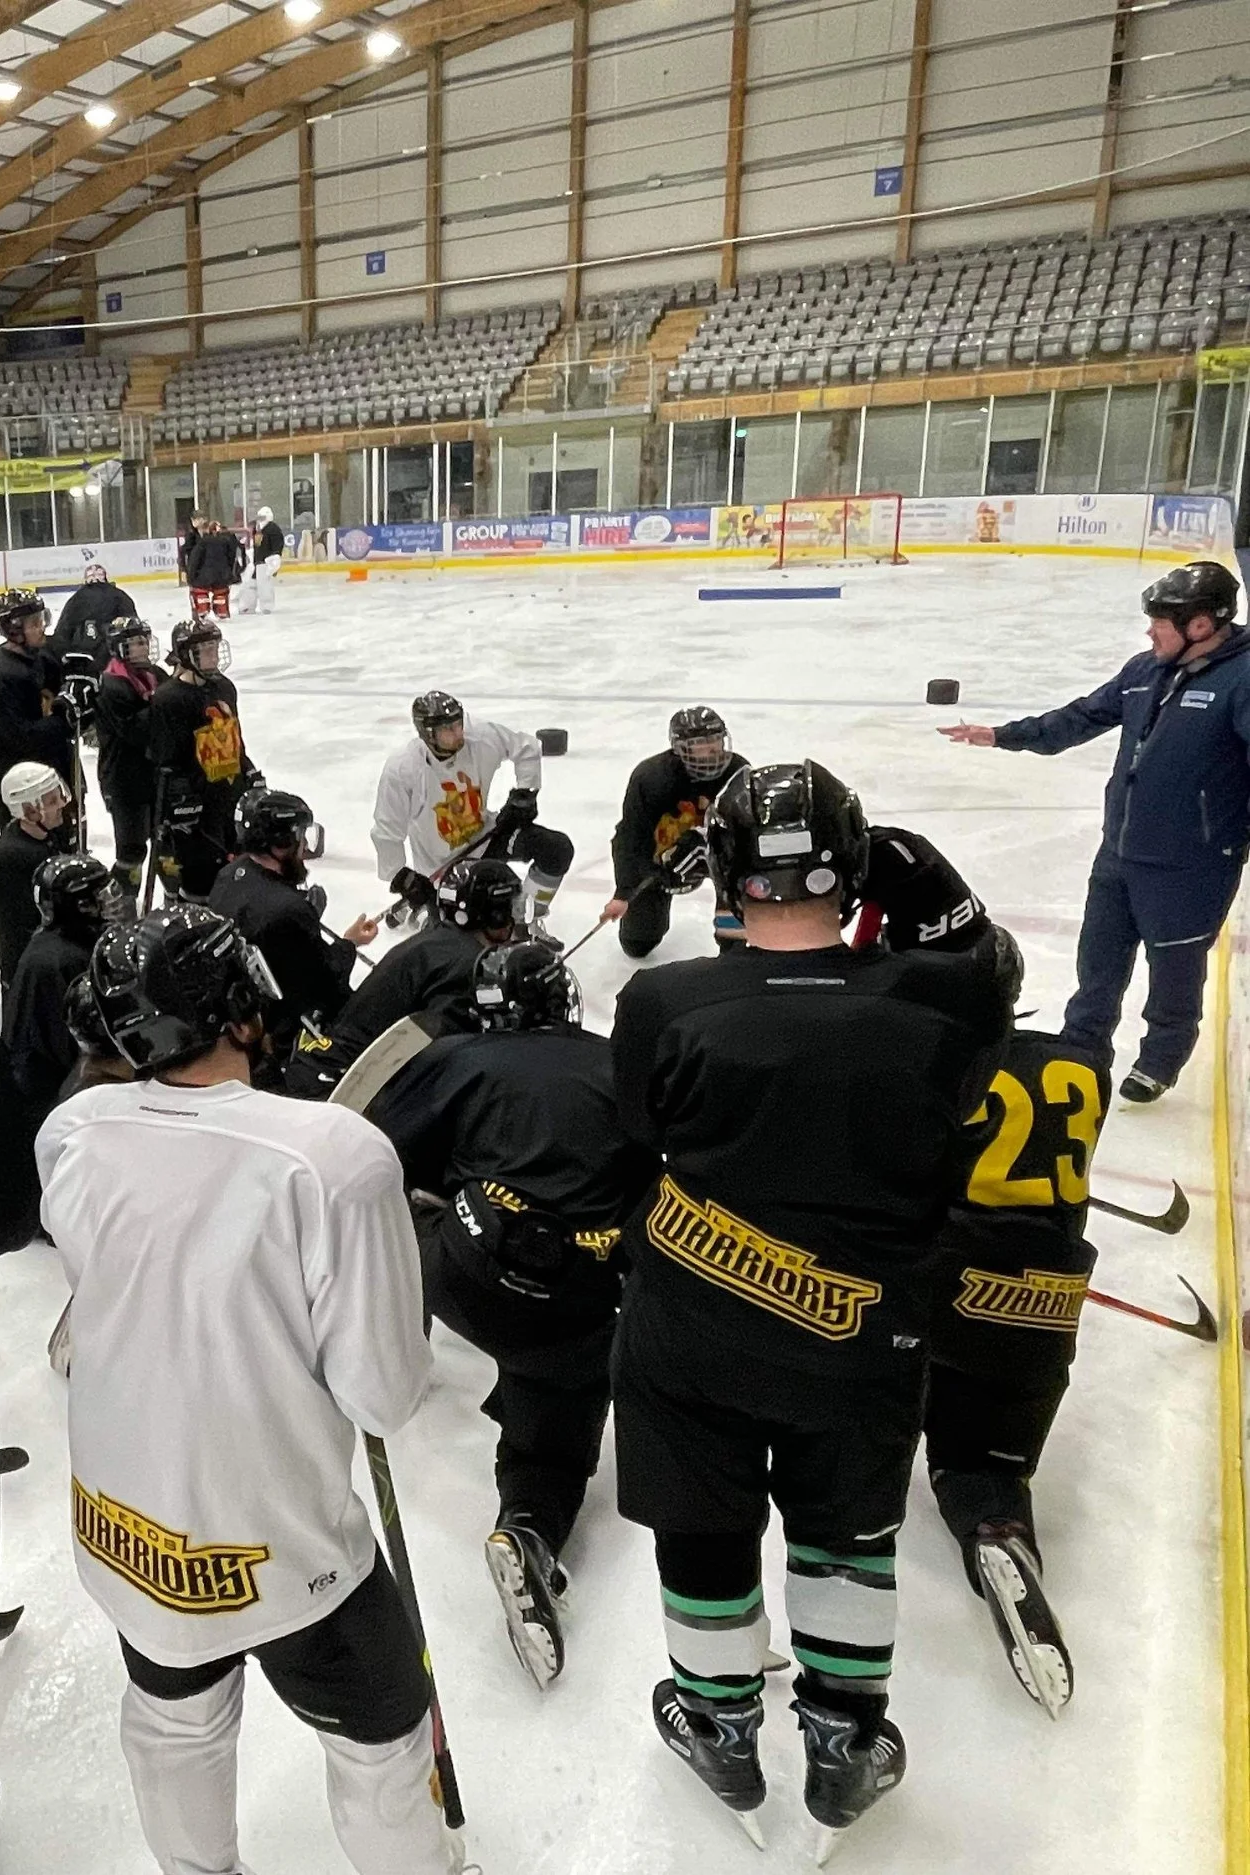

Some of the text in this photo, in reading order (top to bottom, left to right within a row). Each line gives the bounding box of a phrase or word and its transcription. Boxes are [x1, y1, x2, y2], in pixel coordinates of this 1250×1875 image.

[456, 524, 509, 541] GROUP
[584, 516, 632, 528] PRIVATE
[1057, 516, 1107, 535] Hilton
[143, 554, 176, 569] Hilto
[962, 1060, 1102, 1208] 23
[652, 1194, 862, 1325] WARRIORS
[713, 1213, 798, 1266] LEEDS
[73, 1485, 252, 1603] WARRIORS
[105, 1502, 178, 1552] LEEDS
